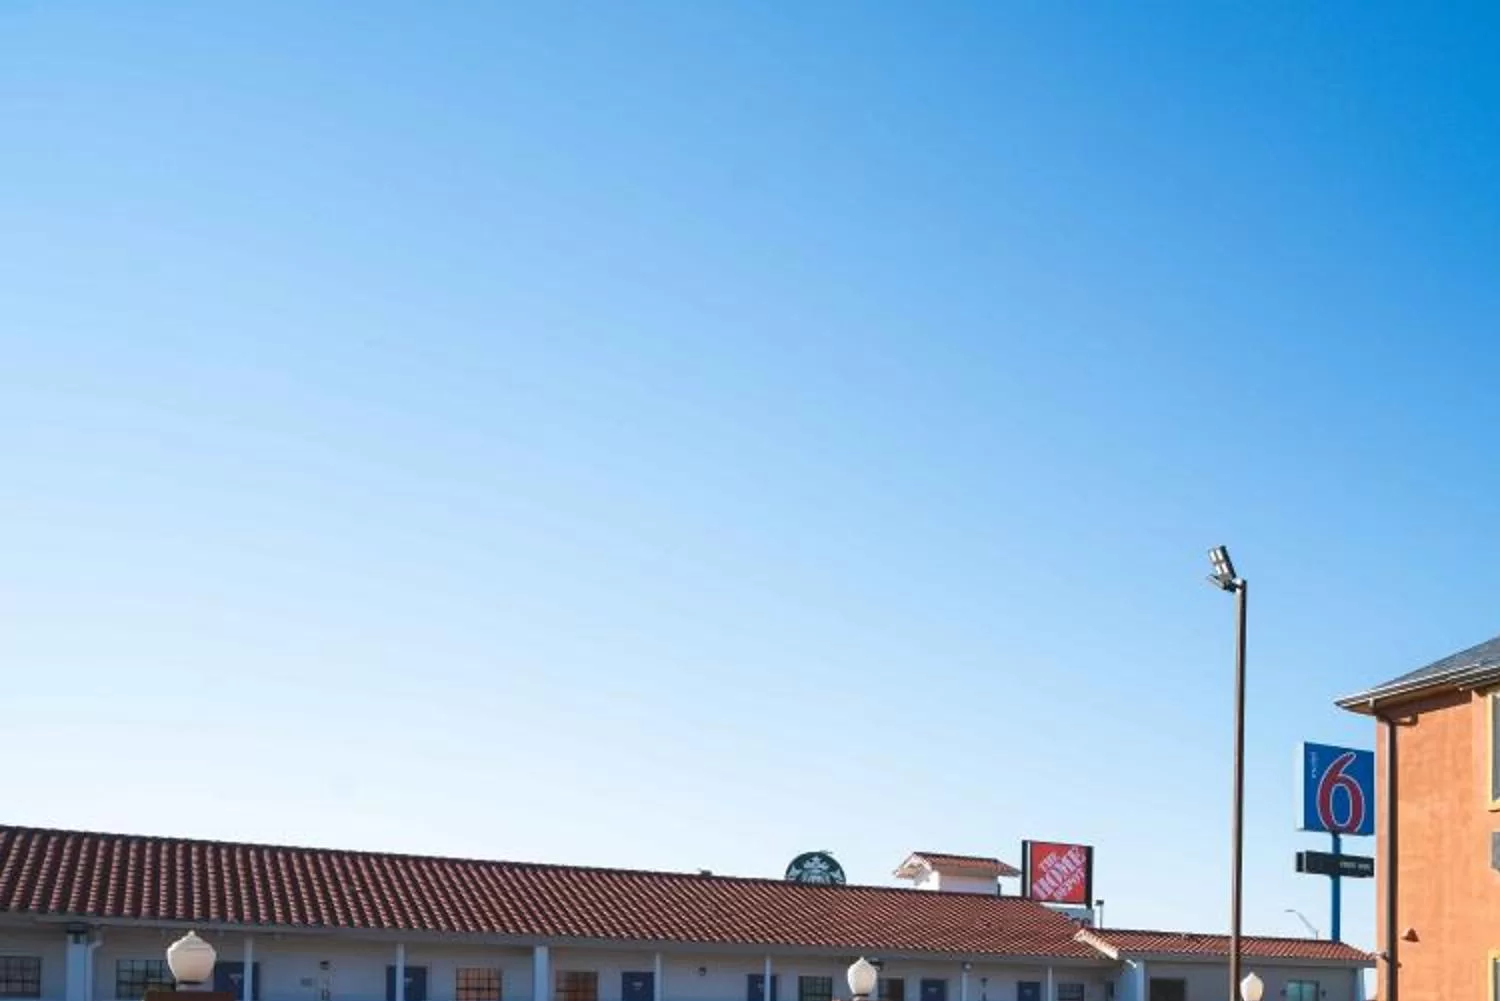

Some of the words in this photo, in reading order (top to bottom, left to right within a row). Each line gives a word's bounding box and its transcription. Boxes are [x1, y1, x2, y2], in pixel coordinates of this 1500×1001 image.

[1316, 751, 1366, 832] 6
[1031, 846, 1087, 900] HOME
[1038, 852, 1058, 872] THE
